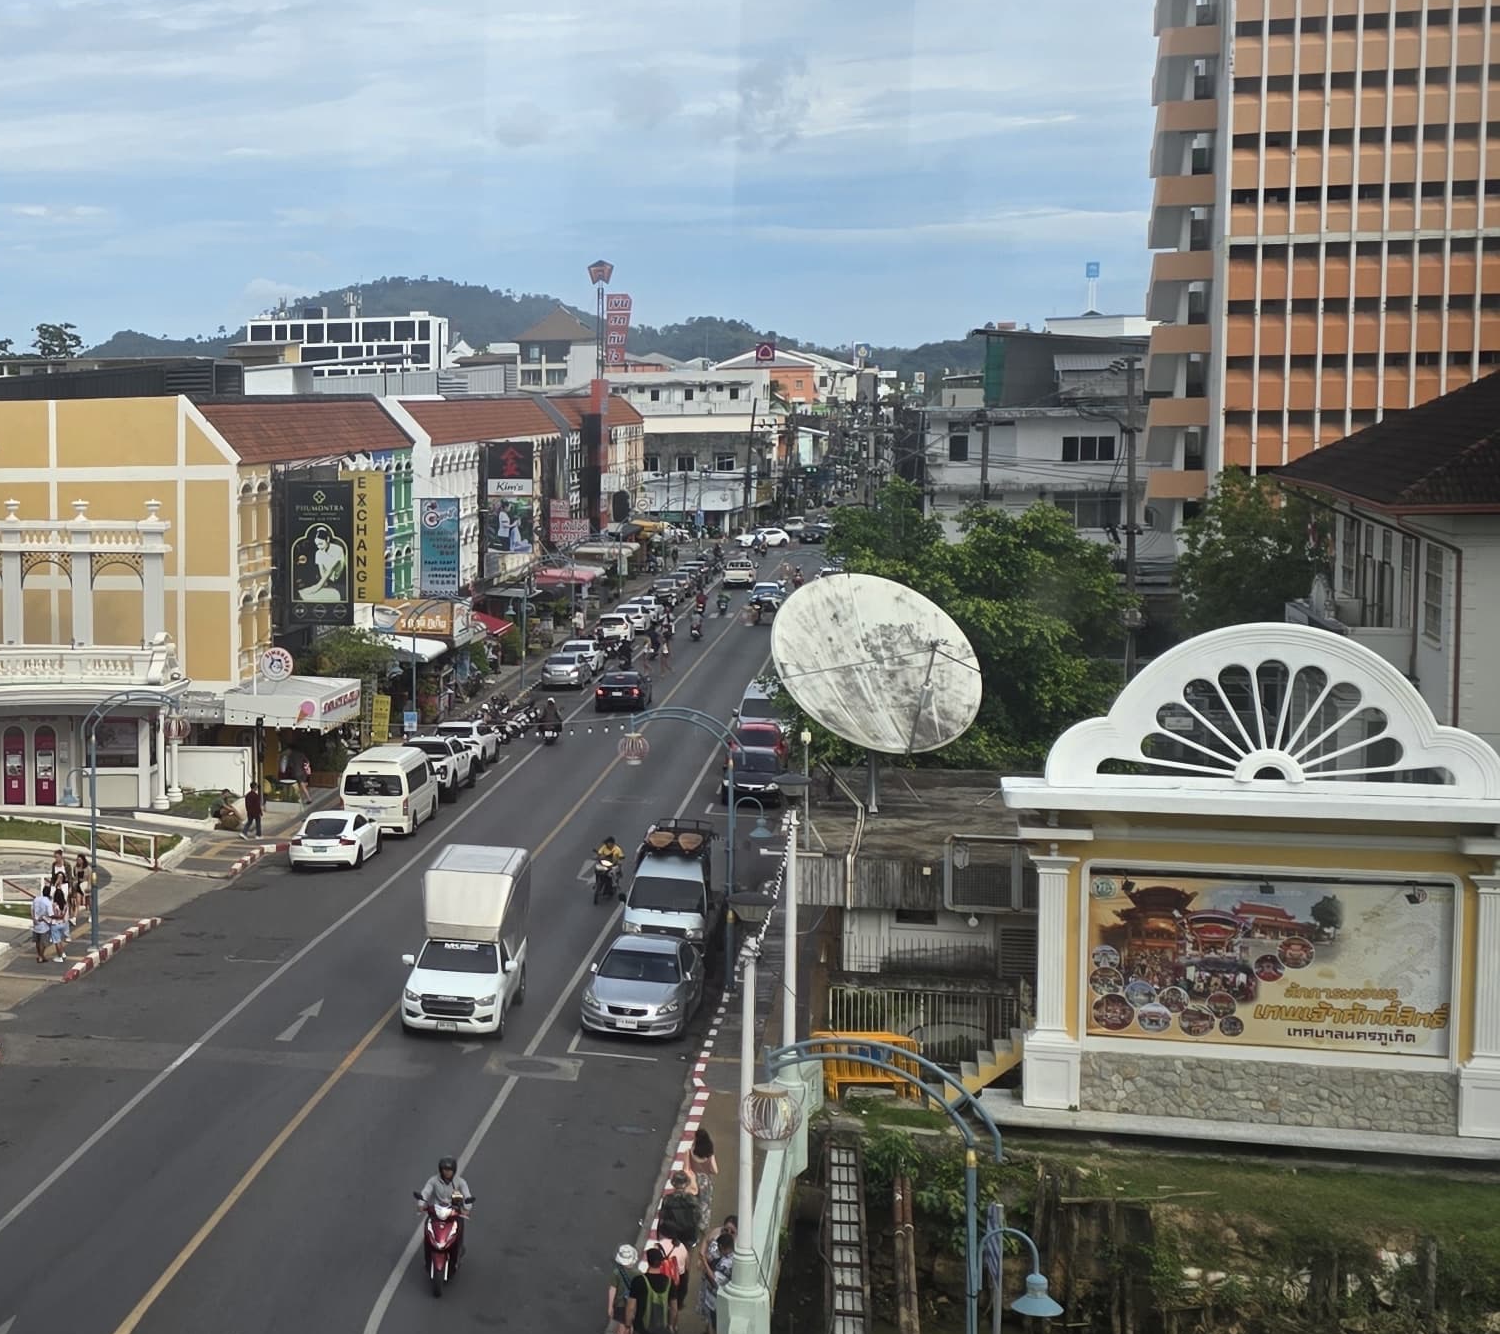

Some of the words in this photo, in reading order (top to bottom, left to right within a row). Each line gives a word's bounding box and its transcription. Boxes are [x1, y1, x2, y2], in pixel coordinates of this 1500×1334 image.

[496, 481, 524, 492] Kim's
[356, 476, 368, 600] EXCHANGE
[1287, 1027, 1417, 1046] เทศบาลนครภูเก็ต
